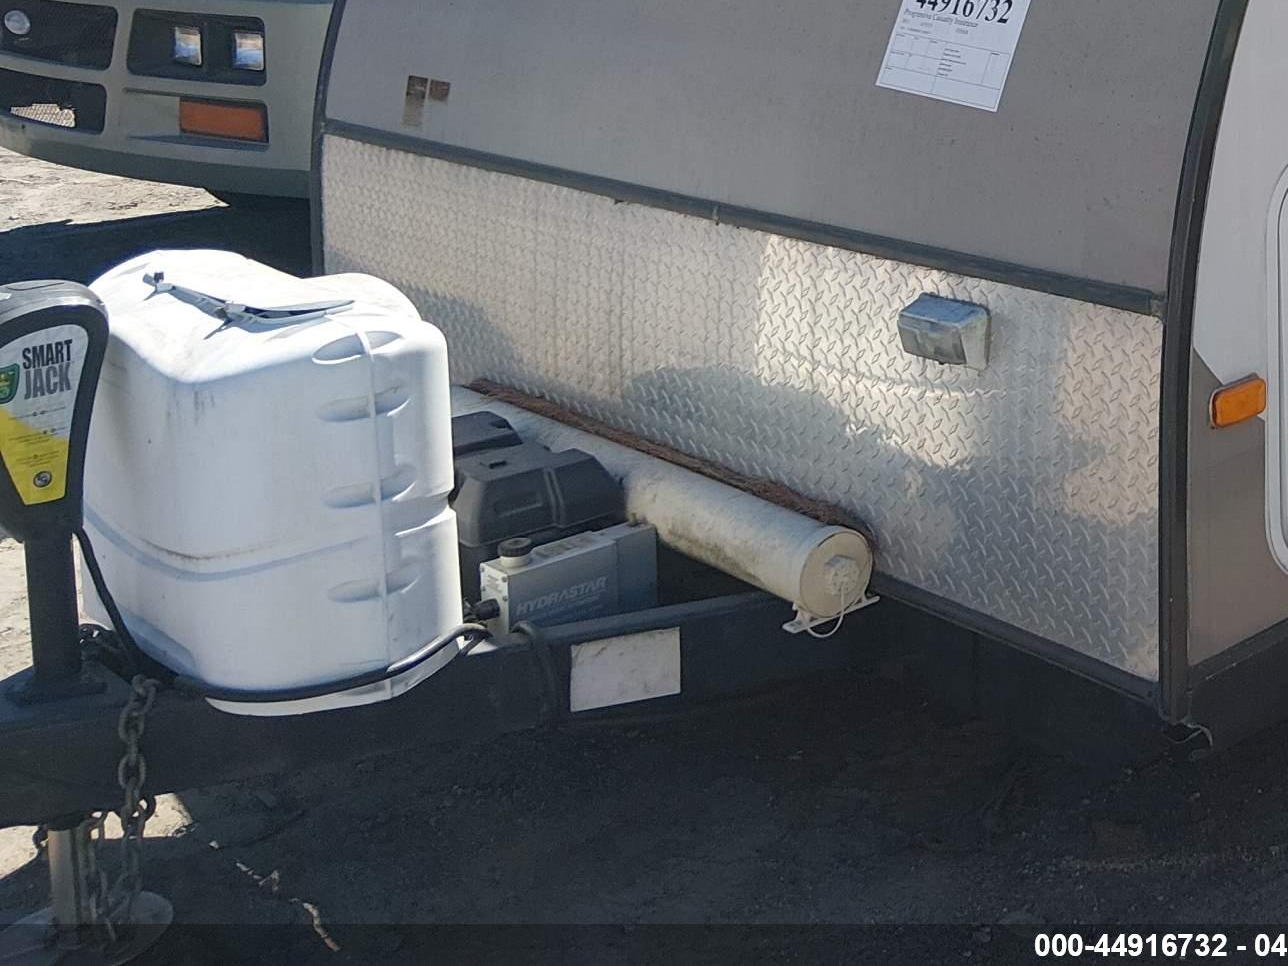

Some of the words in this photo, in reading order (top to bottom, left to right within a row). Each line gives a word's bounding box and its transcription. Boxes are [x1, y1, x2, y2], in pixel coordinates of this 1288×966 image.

[22, 339, 73, 370] SMART
[24, 361, 72, 401] JACK
[515, 576, 609, 616] HYDRASTAR
